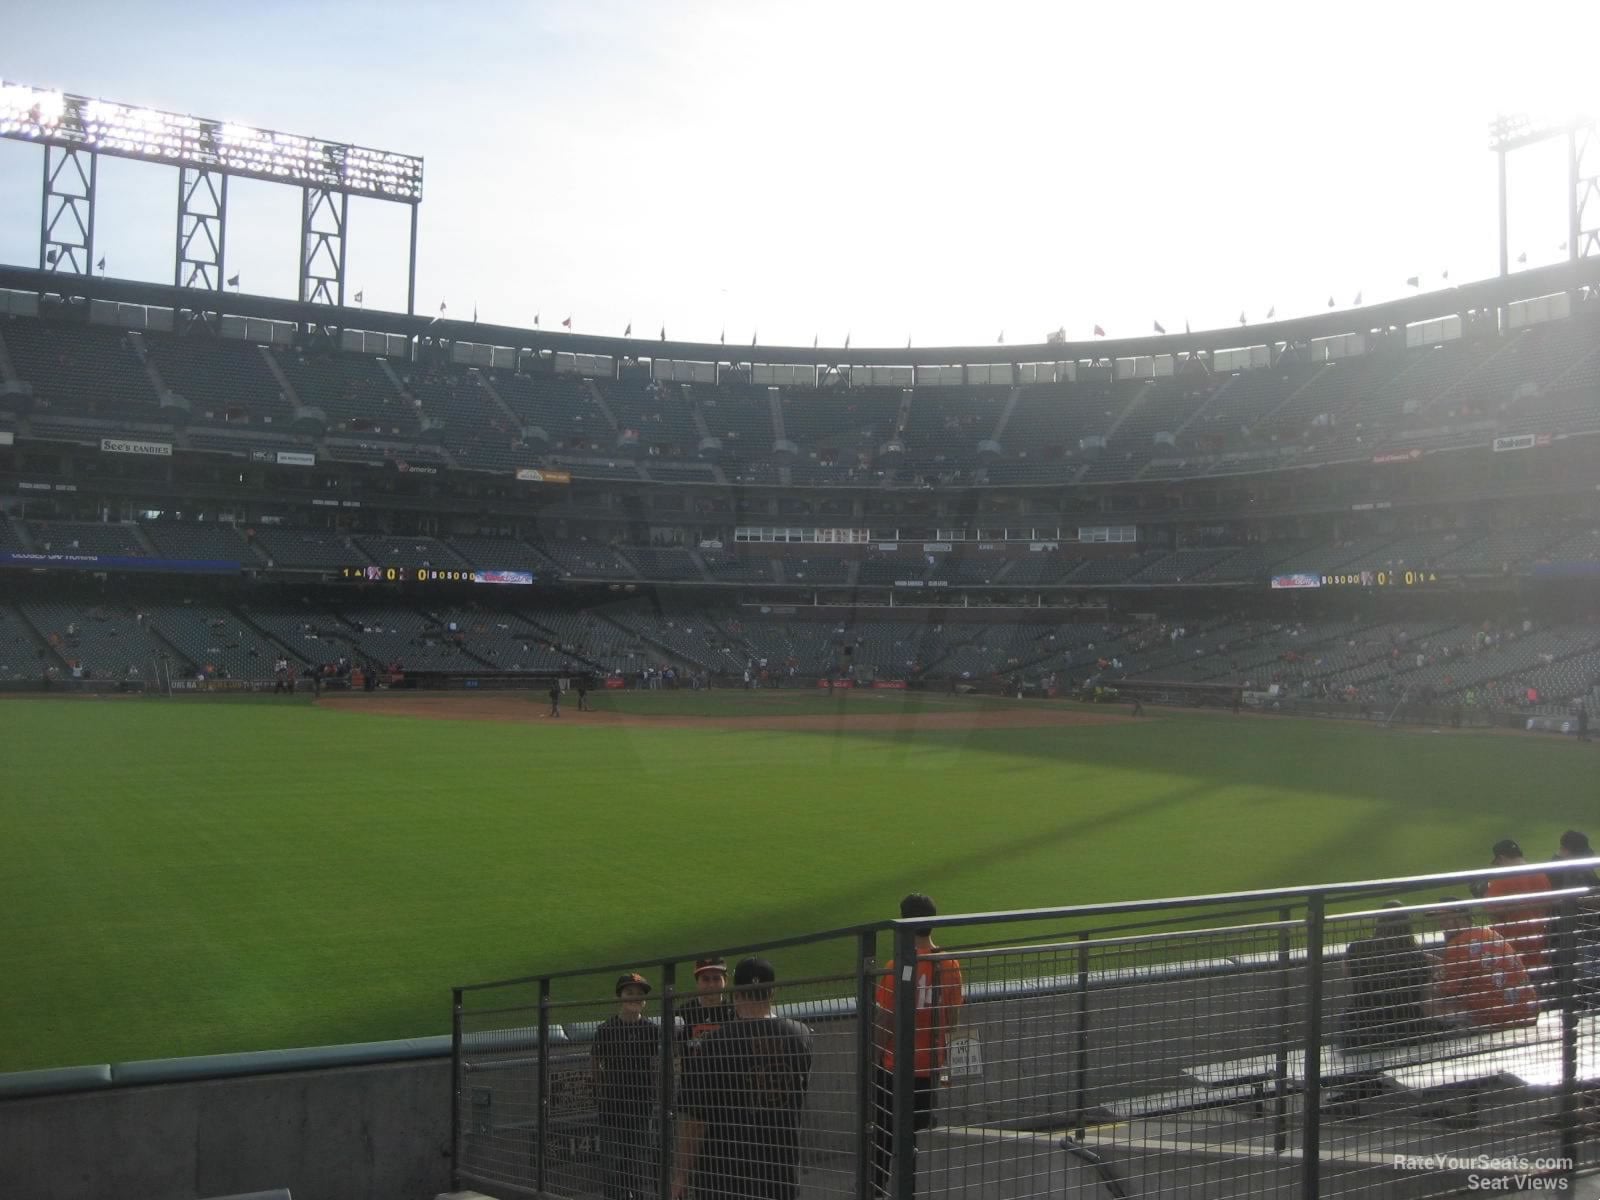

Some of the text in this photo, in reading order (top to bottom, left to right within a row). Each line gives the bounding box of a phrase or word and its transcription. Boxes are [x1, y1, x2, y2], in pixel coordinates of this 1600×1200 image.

[104, 440, 169, 454] See's CANDIES
[386, 568, 395, 580] 0
[417, 569, 426, 581] 0
